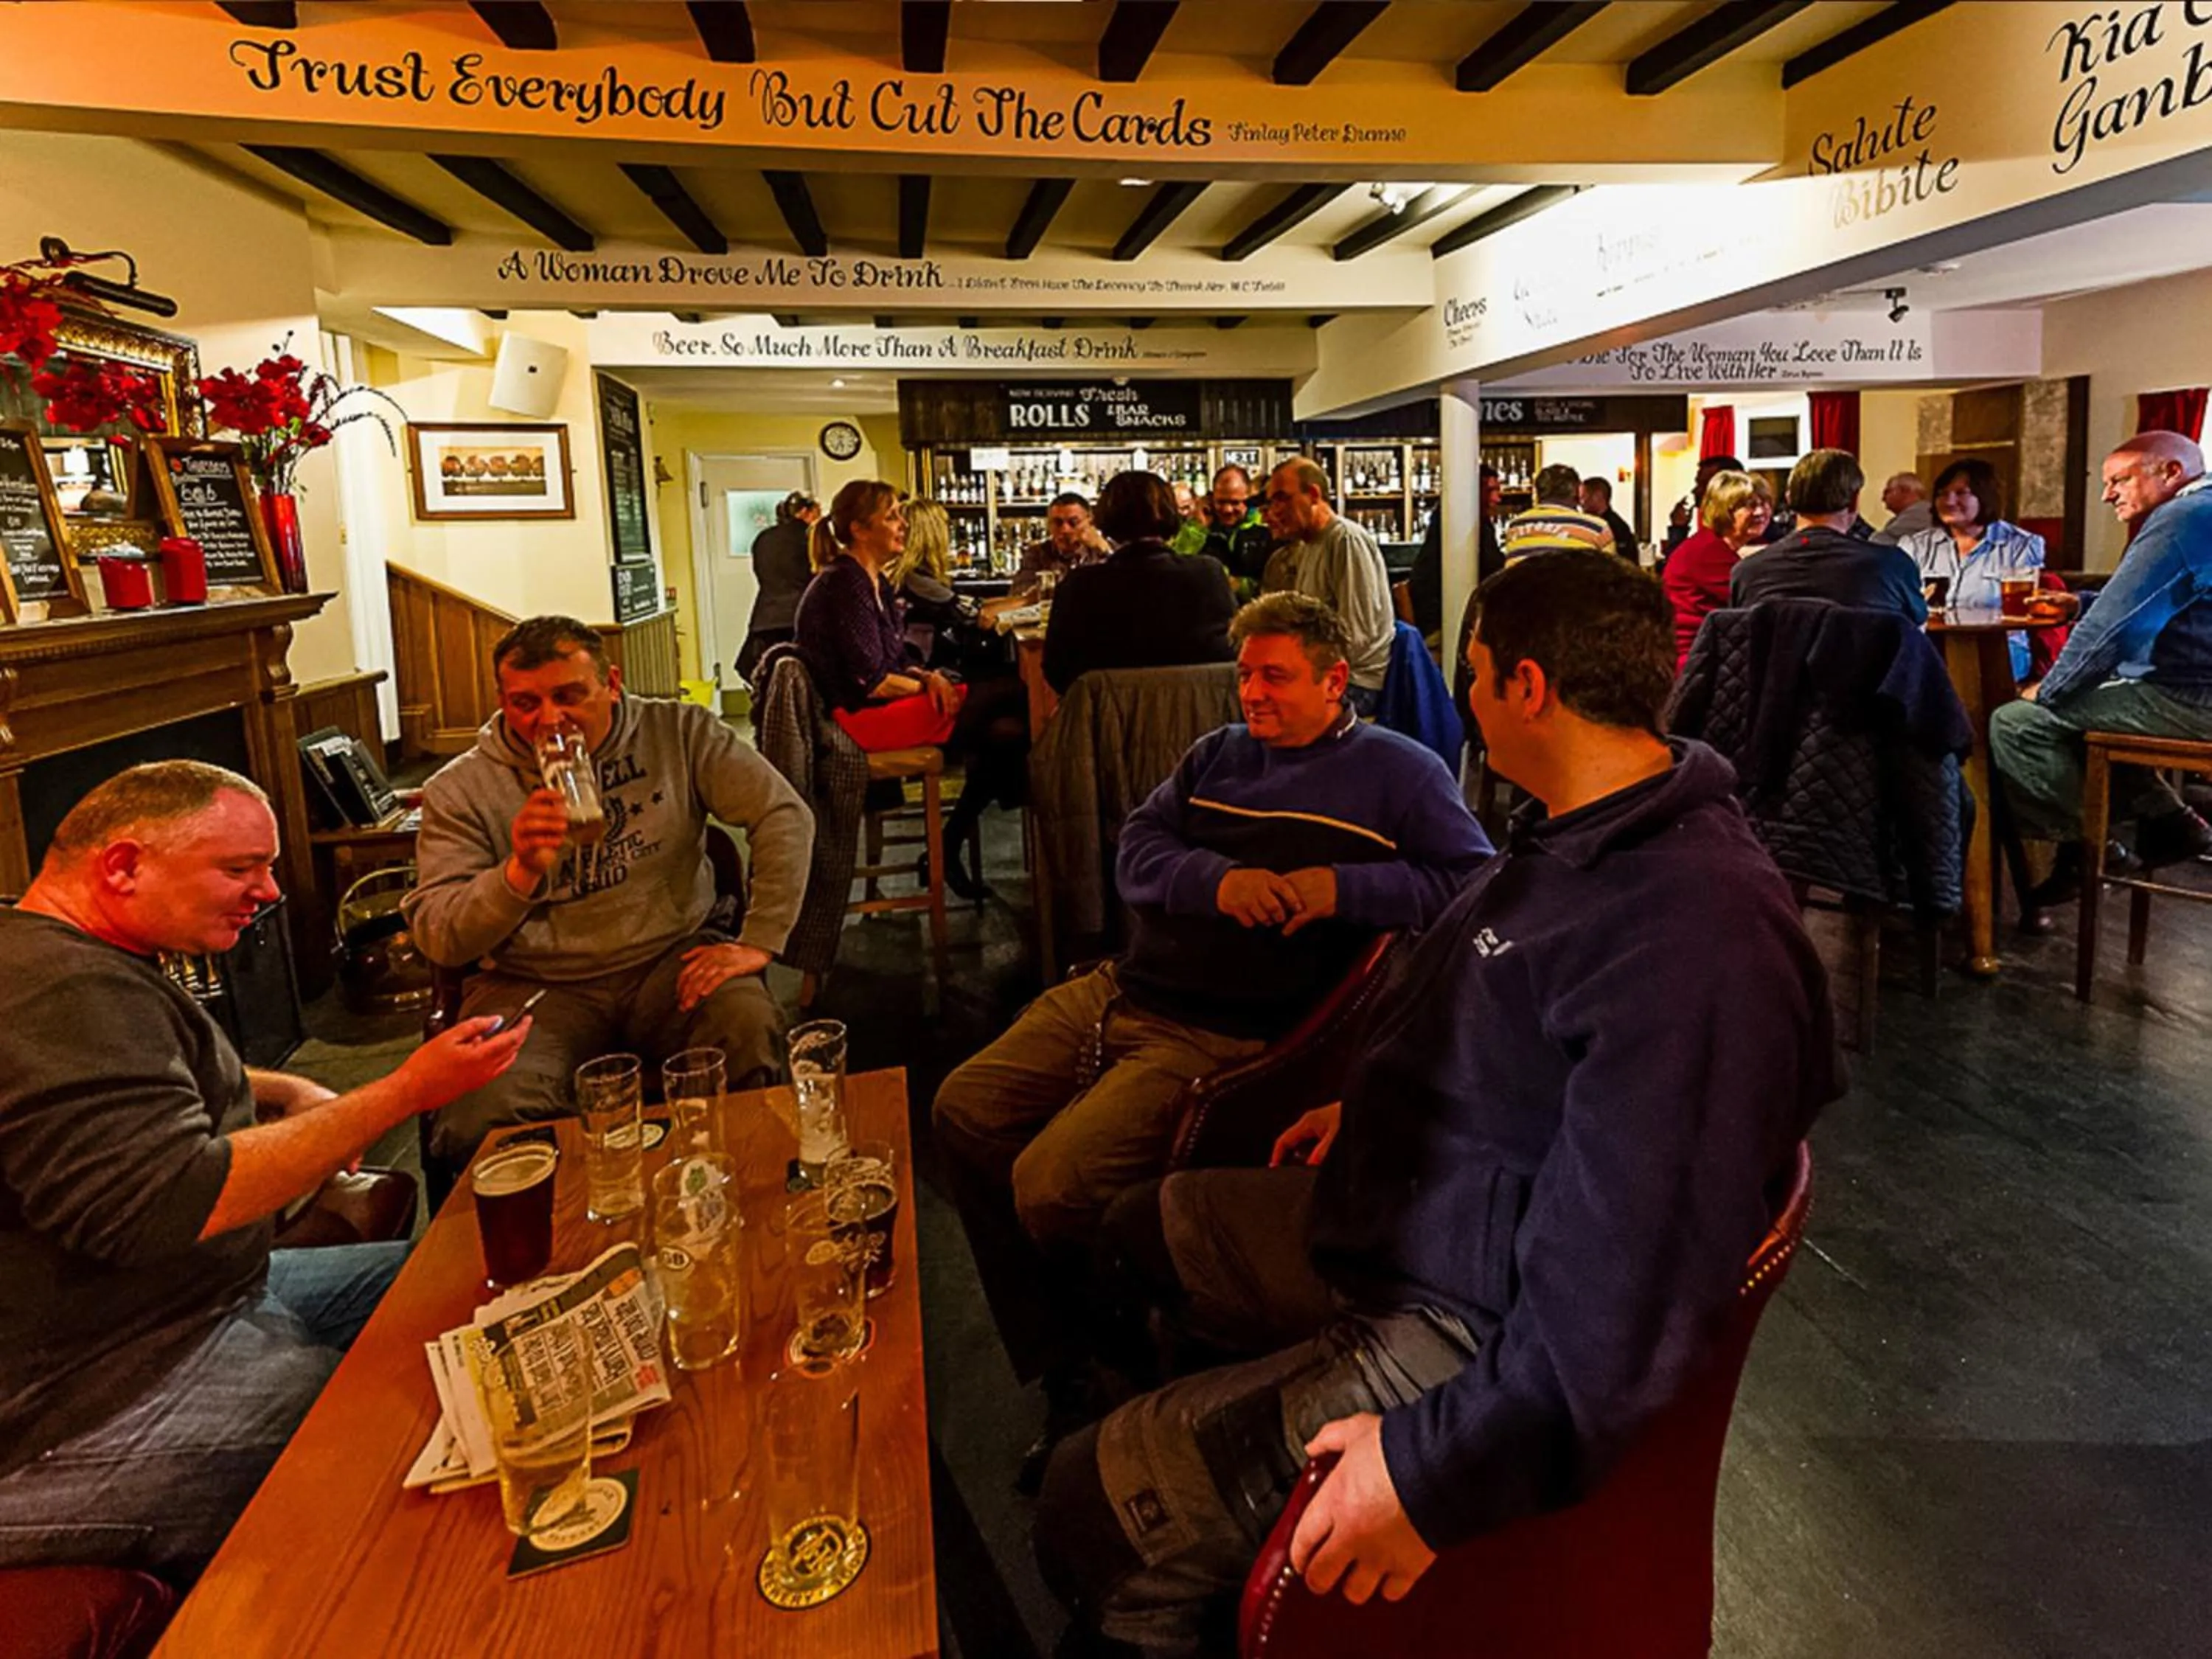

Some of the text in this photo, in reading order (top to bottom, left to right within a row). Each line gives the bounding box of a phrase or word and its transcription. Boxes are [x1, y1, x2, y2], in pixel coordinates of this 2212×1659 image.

[2045, 3, 2165, 83] Kia
[229, 40, 1211, 146] Trust Everybody But Cut The Cards
[2052, 42, 2212, 173] Ganb
[1227, 121, 1290, 145] Finlay
[1293, 122, 1338, 142] Peter
[1808, 95, 1937, 177] Salute
[1831, 149, 1960, 229] Bibite
[498, 250, 946, 288] A Woman Drove Me To Drink
[1443, 296, 1487, 327] Cheers
[720, 331, 745, 355] So
[748, 333, 812, 357] Much
[816, 334, 872, 358] More
[875, 335, 933, 358] Than
[938, 335, 957, 358] A
[963, 335, 1066, 361] Breakfast
[1074, 335, 1138, 360] Drink
[1652, 341, 1686, 364] The
[1688, 341, 1756, 364] Woman
[1759, 341, 1789, 363] You
[1792, 340, 1837, 363] Love
[1841, 339, 1885, 362] Than
[1629, 364, 1656, 381] To
[1659, 362, 1705, 381] Live
[1009, 403, 1091, 428] ROLLS
[1116, 414, 1186, 428] SNACKS
